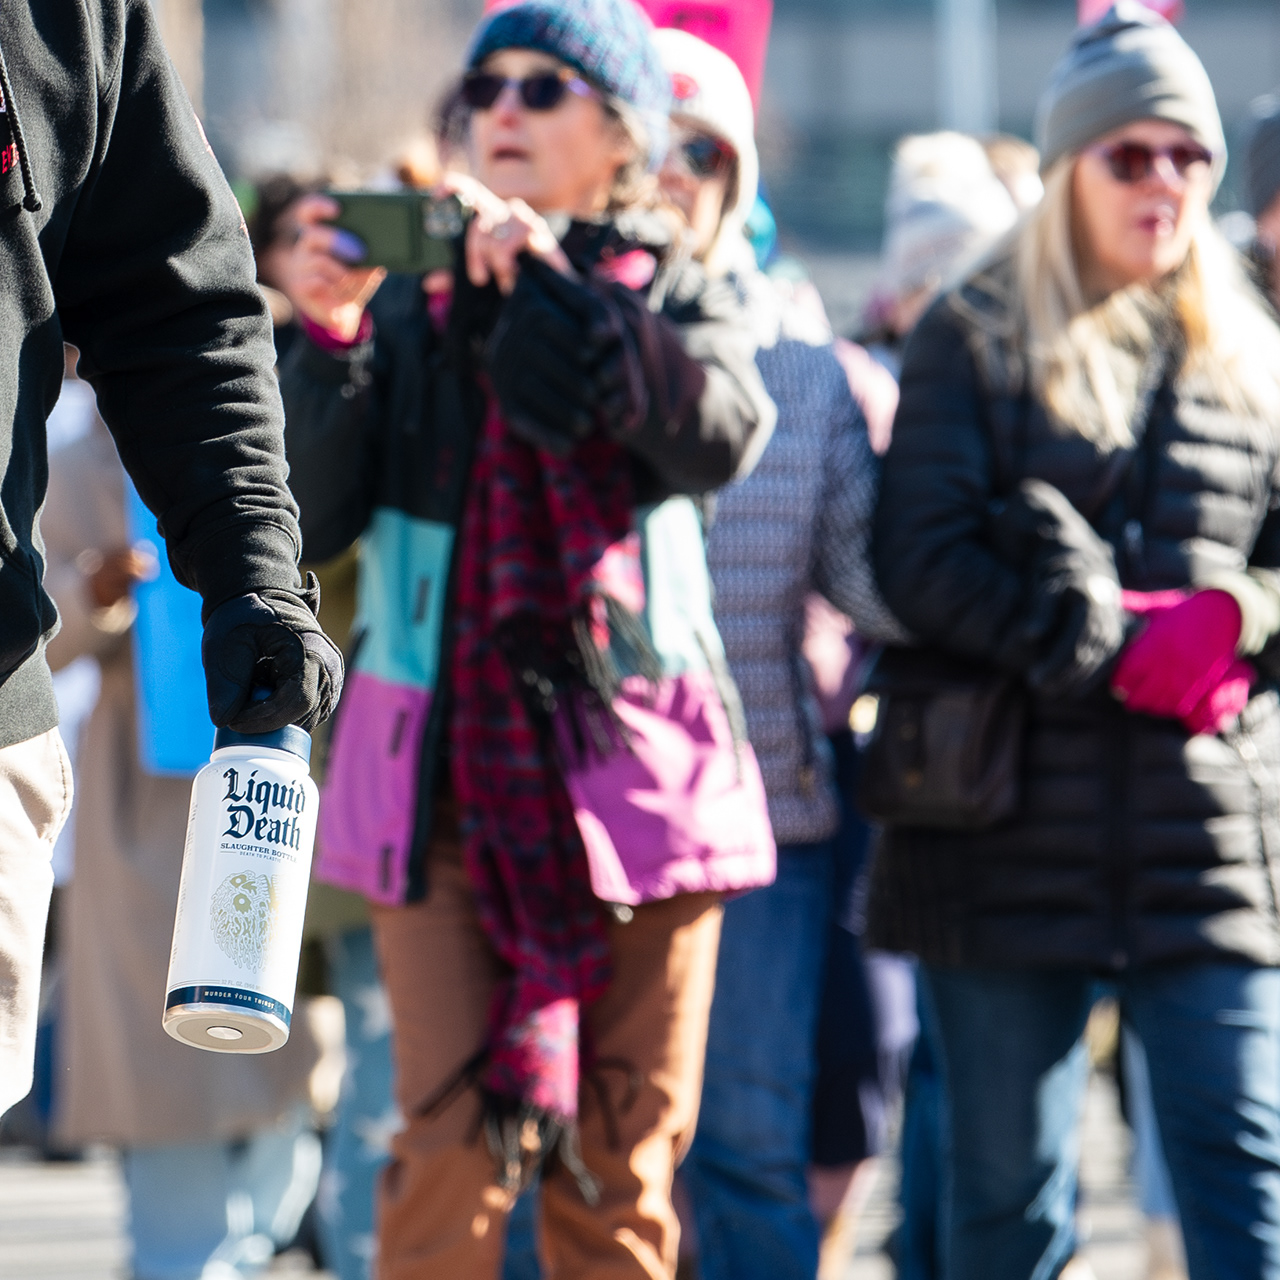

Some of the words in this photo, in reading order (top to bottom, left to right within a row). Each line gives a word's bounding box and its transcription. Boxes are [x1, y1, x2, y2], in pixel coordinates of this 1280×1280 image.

[222, 767, 306, 816] Liquid
[222, 803, 301, 851] Death
[220, 842, 270, 855] SLAUGHTER
[234, 992, 252, 1002] YOUR
